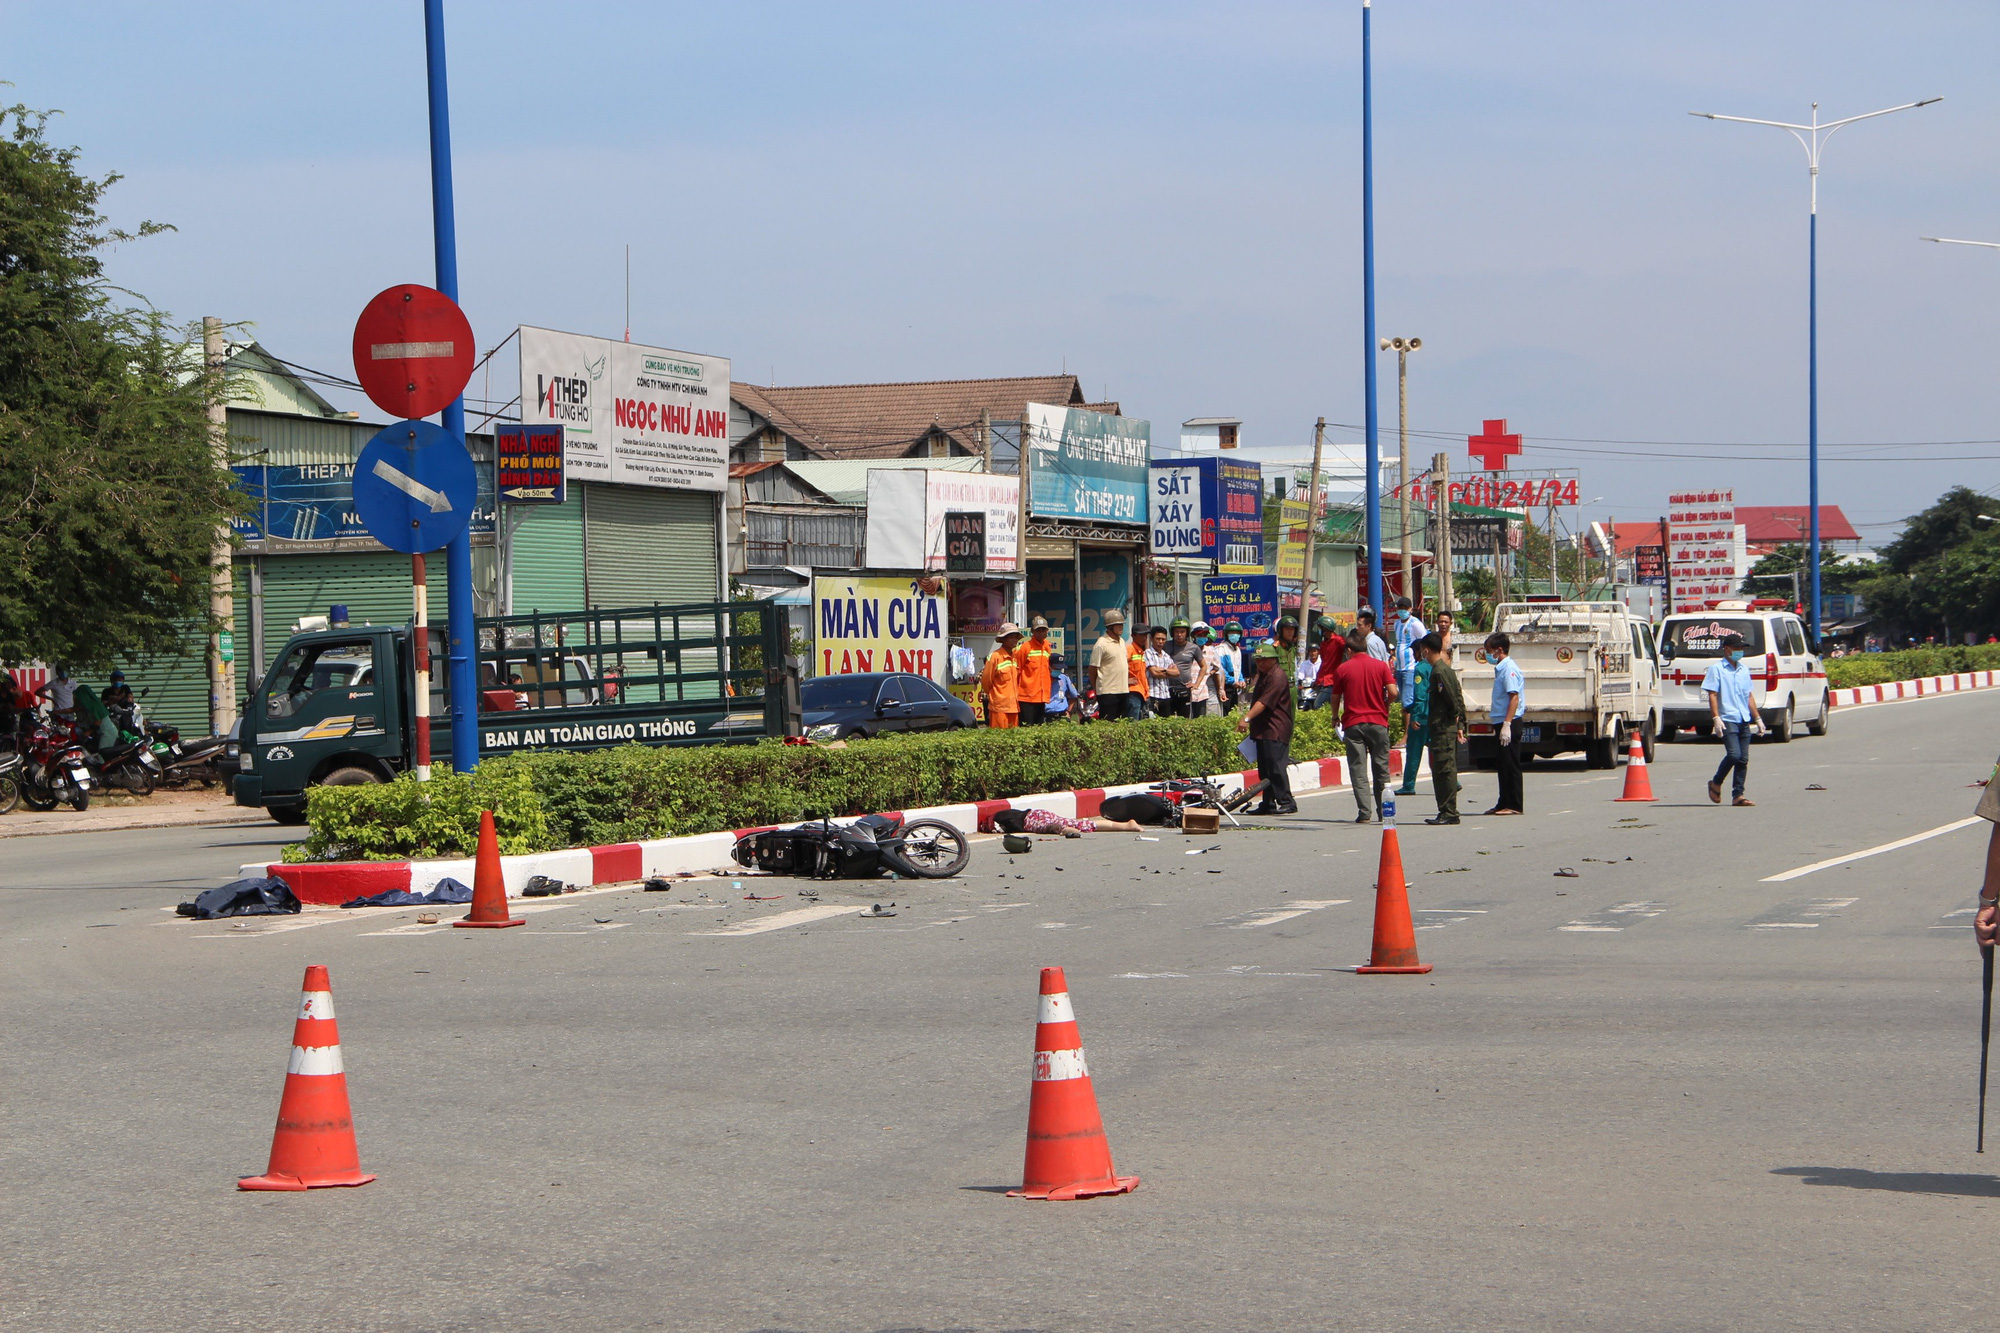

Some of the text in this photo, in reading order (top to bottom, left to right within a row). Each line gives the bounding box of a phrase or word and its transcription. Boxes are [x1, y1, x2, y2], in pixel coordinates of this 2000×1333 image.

[554, 372, 588, 404] THÉP
[555, 403, 589, 422] TUNG HO
[615, 398, 726, 439] NGỌC NHƯ ANH
[500, 453, 529, 469] PHỐ
[532, 454, 561, 469] MỚI
[500, 469, 561, 486] BÌNH DÂN
[1157, 470, 1192, 496] SẮT
[1158, 500, 1193, 523] XÂY
[948, 515, 982, 534] MÀN
[949, 535, 981, 556] CỬA
[1154, 525, 1201, 551] DỰNG
[1637, 555, 1661, 563] KHOA
[1204, 582, 1228, 594] Cung
[821, 581, 941, 639] MÀN CỬA
[1204, 595, 1224, 605] Bán
[1239, 594, 1247, 603] &
[485, 718, 696, 747] BAN AN TOÀN GIAO THÔNG
